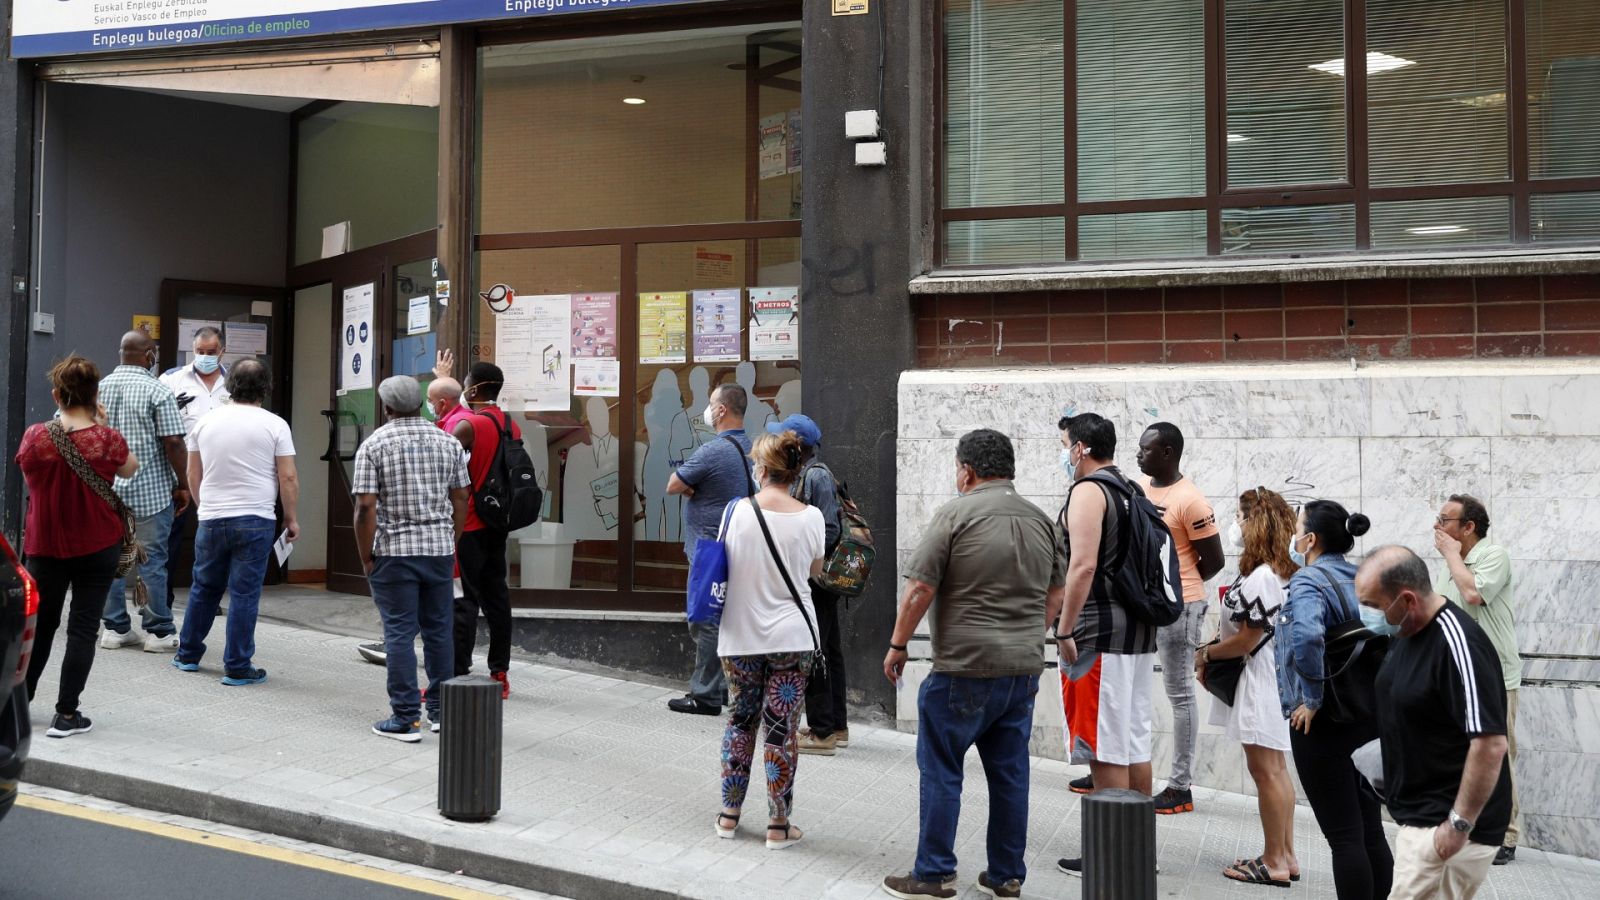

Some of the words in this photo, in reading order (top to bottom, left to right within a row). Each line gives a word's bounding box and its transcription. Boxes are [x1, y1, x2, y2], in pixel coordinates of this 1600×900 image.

[94, 3, 123, 13] Euskal
[126, 0, 162, 11] Enplegu
[94, 15, 129, 25] Servicio
[132, 13, 157, 22] Vasco
[160, 10, 171, 20] de
[174, 8, 207, 19] Empleo
[93, 32, 144, 47] Enplegu
[247, 21, 262, 33] de
[265, 18, 310, 33] empleo
